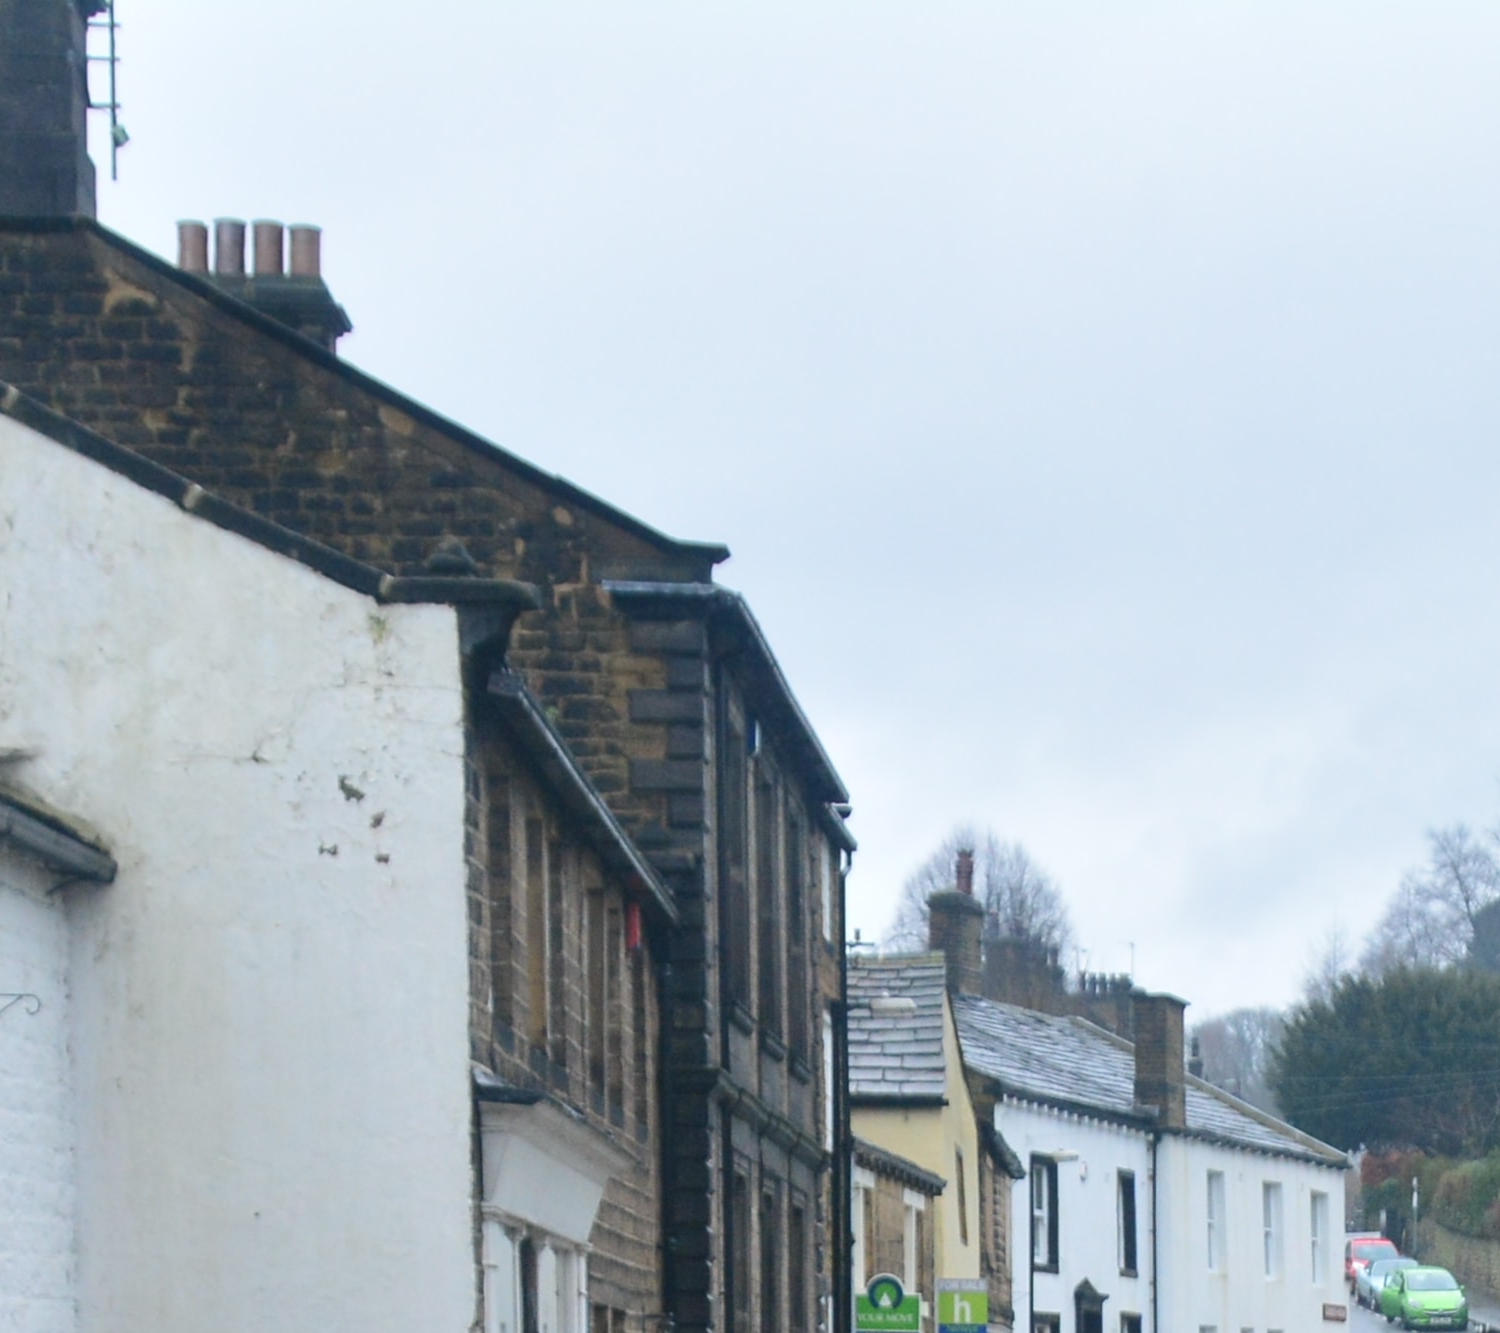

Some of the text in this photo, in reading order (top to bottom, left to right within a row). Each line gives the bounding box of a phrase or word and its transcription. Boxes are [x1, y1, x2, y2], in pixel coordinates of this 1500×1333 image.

[857, 1313, 913, 1322] YOUR MOVE
[953, 1293, 972, 1323] h
